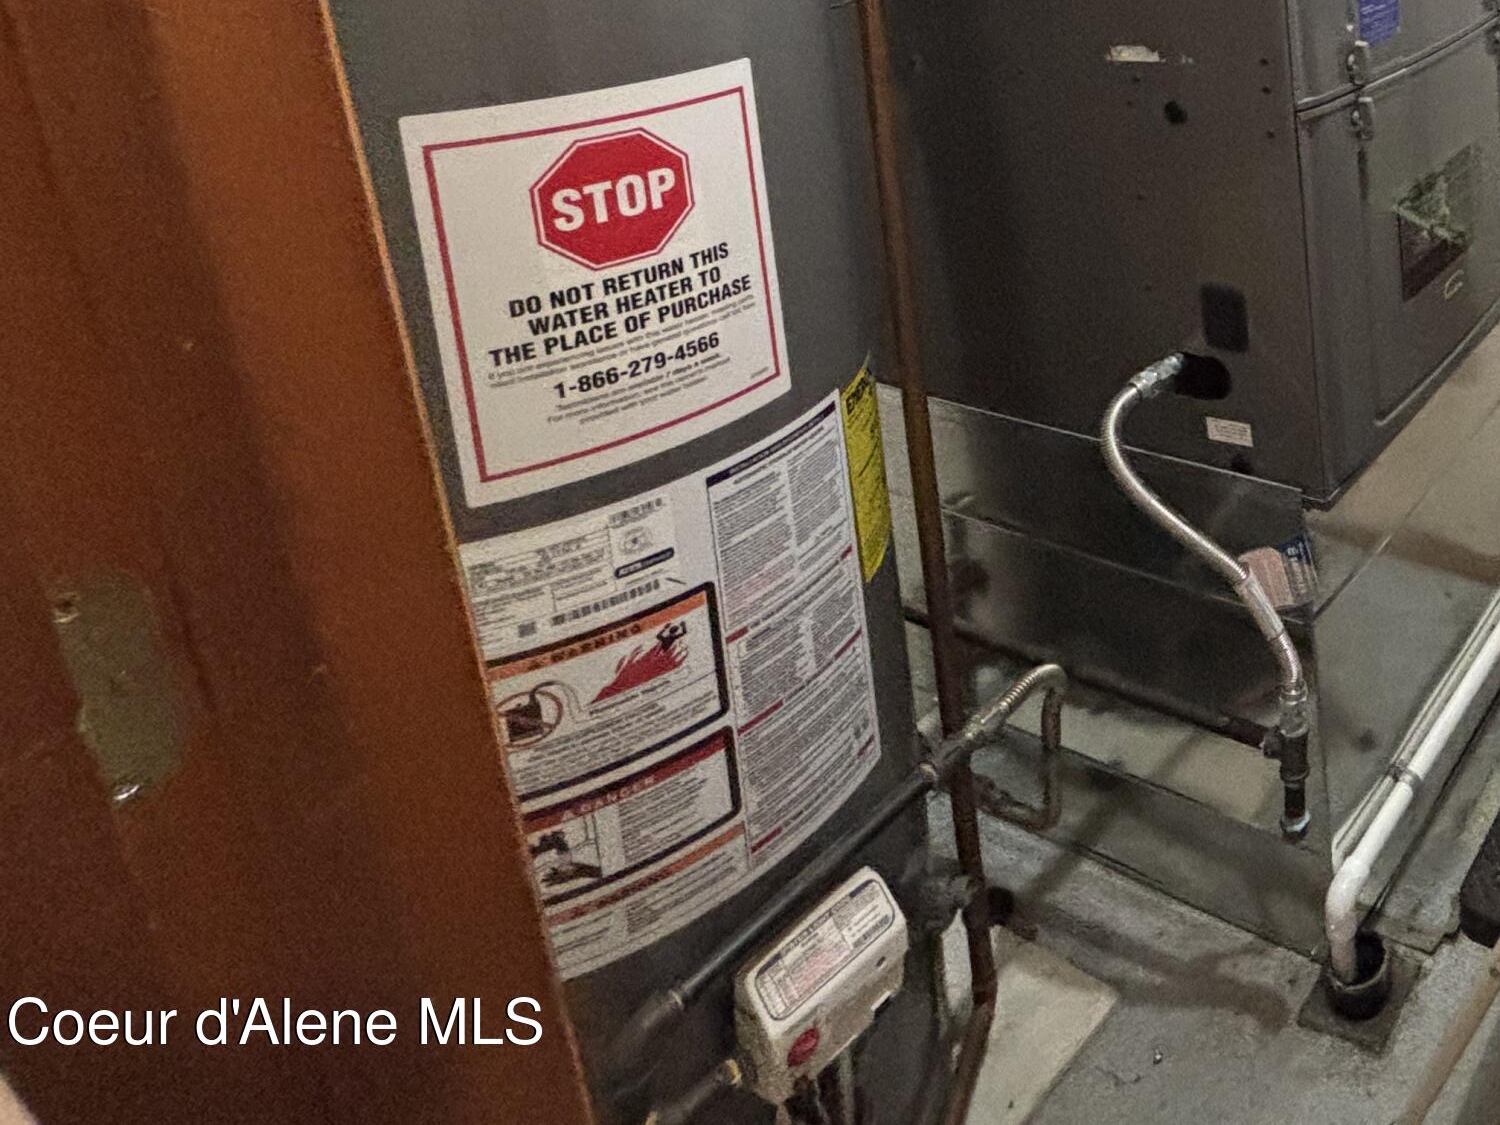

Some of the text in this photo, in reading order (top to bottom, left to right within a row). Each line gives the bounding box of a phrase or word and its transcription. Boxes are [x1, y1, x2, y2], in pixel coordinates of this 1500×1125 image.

[552, 167, 676, 232] STOP
[508, 242, 729, 318] DO NOT RETURN THIS
[528, 301, 609, 336] WATER
[616, 276, 693, 314] HEATER
[699, 266, 721, 287] TO
[488, 275, 751, 368] THE PLACE OF PURCHASE
[553, 331, 720, 399] 1-866-279-4566
